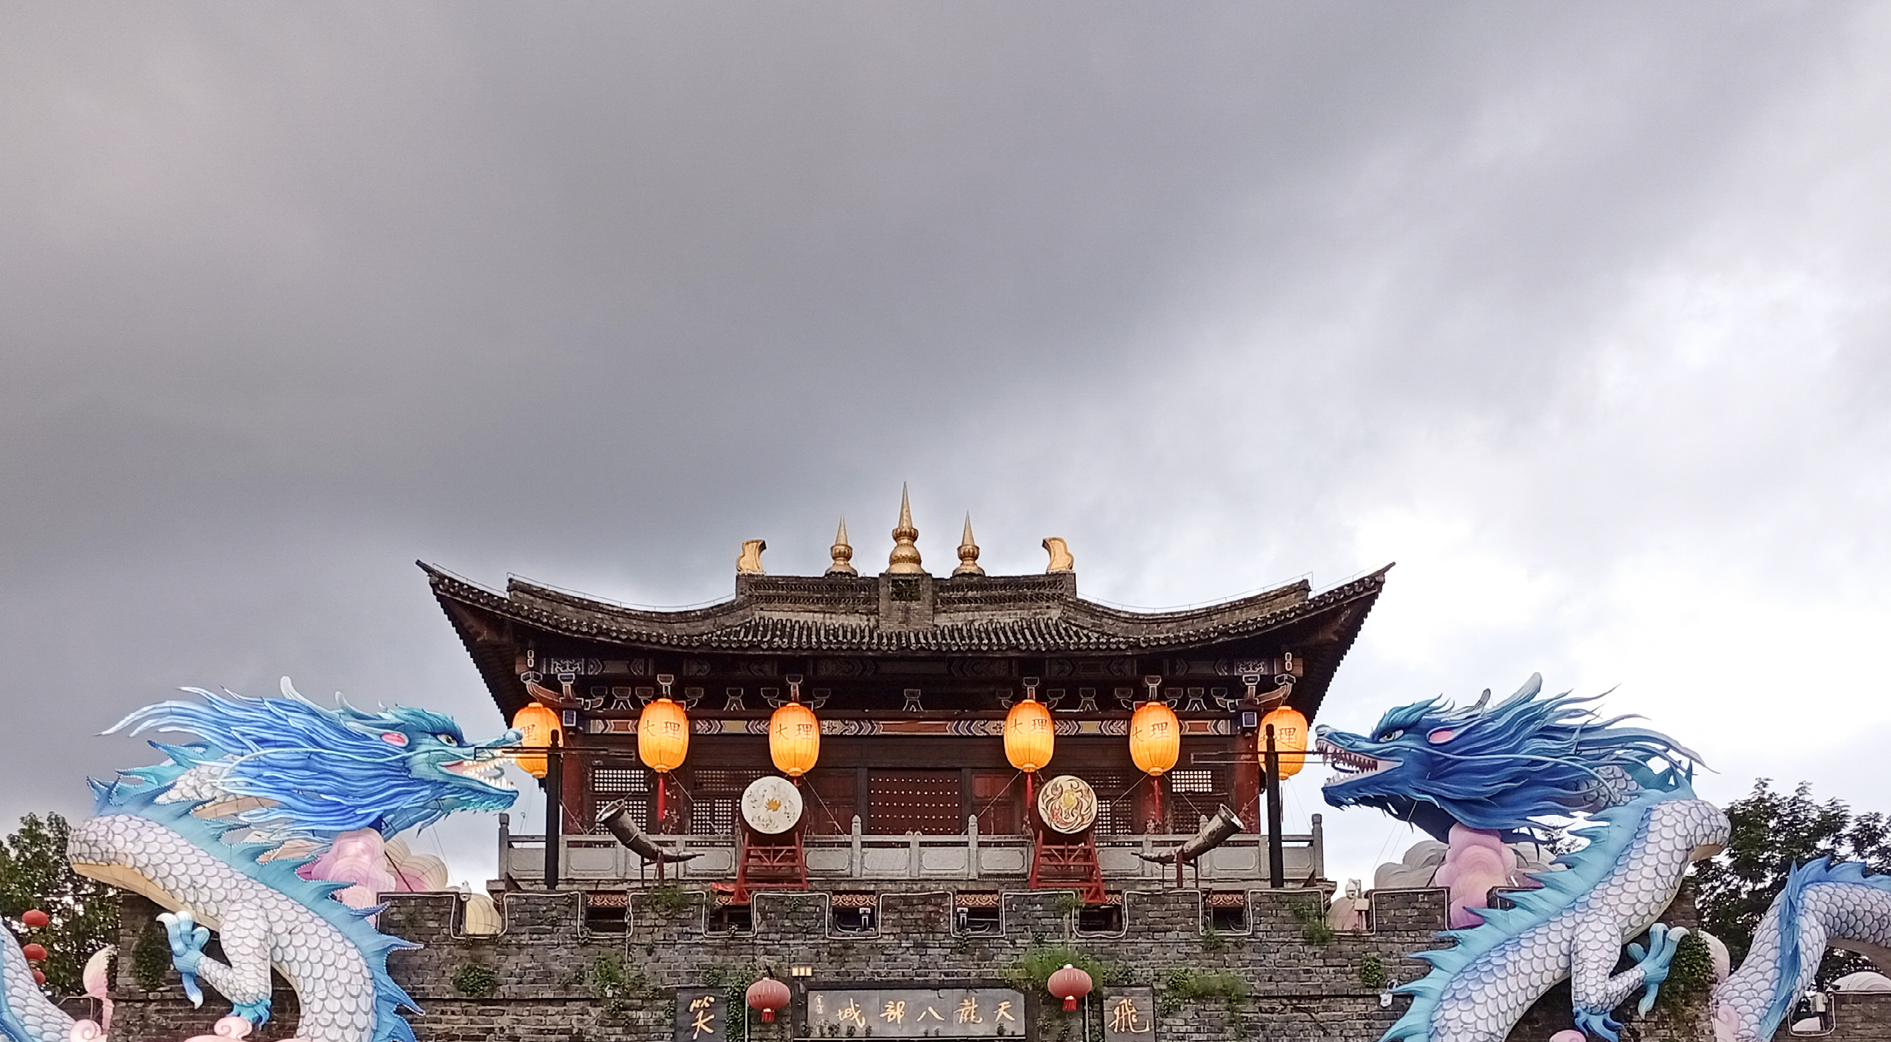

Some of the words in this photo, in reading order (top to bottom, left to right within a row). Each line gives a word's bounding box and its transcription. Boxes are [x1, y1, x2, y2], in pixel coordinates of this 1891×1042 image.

[643, 719, 681, 742] 大理
[775, 723, 814, 743] 大理
[1010, 718, 1048, 736] 大理
[1132, 721, 1169, 744] 大理
